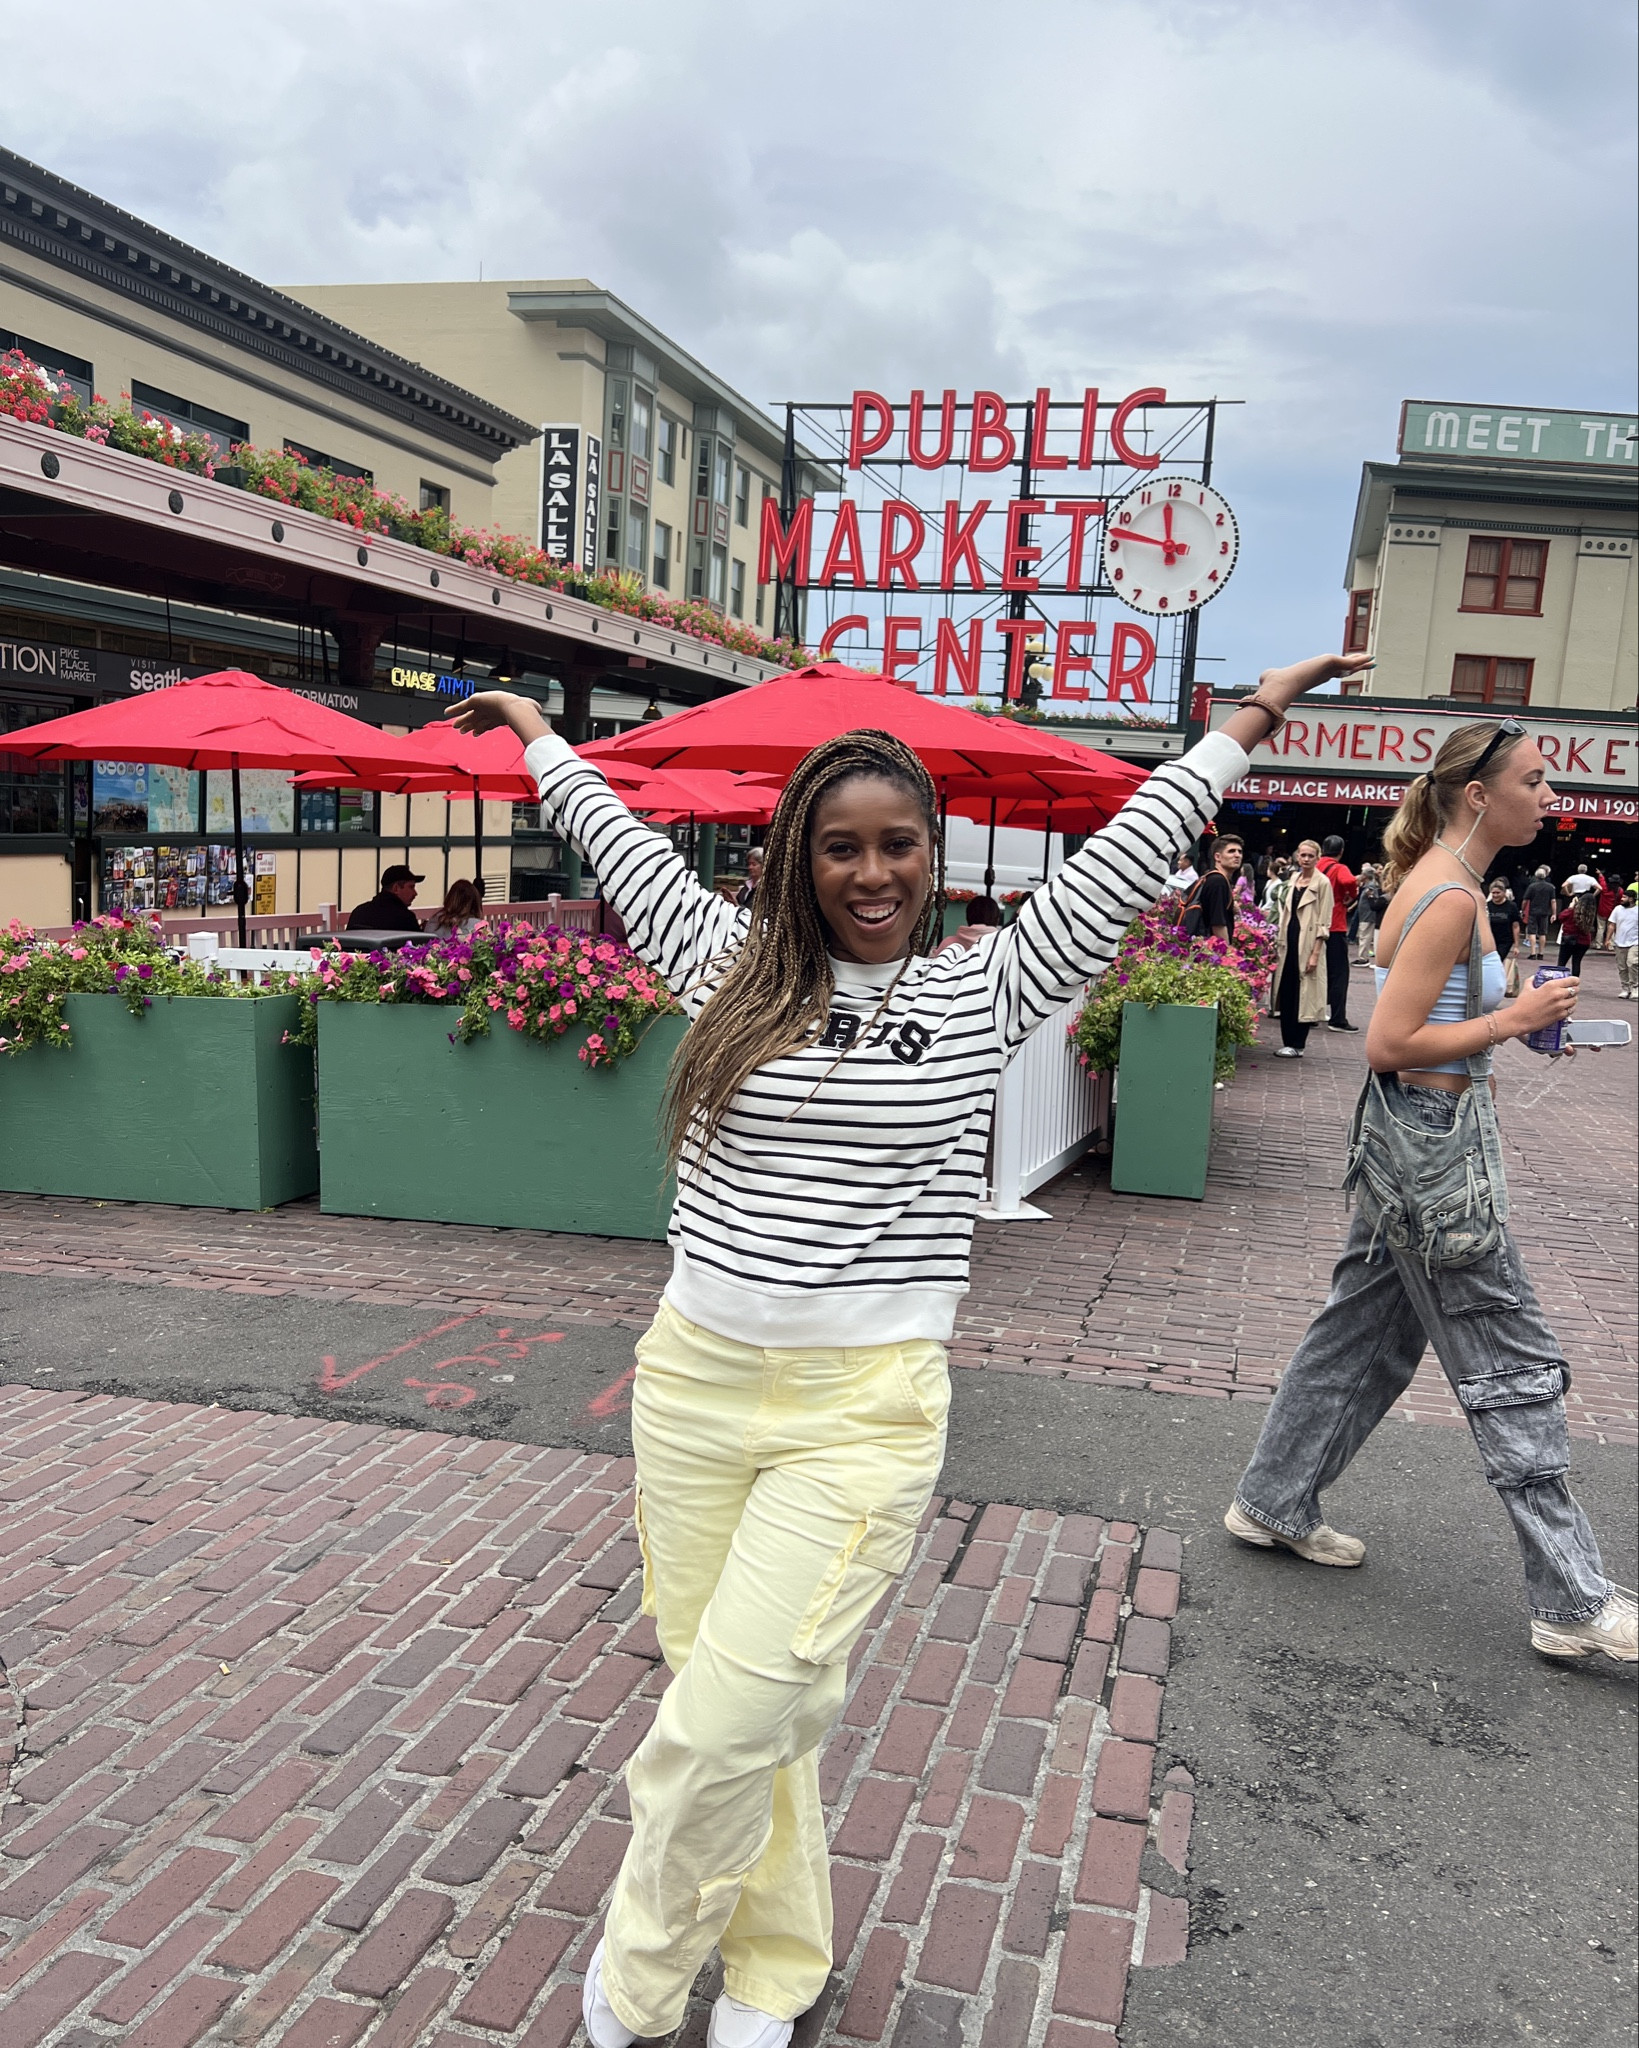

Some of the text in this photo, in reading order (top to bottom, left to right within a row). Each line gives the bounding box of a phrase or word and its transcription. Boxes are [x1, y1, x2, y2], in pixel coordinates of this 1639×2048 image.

[848, 387, 1167, 473] PUBLIC
[1424, 410, 1637, 460] MEET TH
[546, 432, 572, 559] LA SALLE
[1168, 483, 1182, 497] 12
[584, 439, 599, 567] LA SALLE
[1141, 491, 1152, 505] 11
[1199, 492, 1204, 505] 1
[1119, 511, 1132, 525] 10
[1215, 512, 1225, 526] 2
[757, 497, 1107, 593] MARKET
[1109, 539, 1120, 553] 9
[1219, 541, 1229, 555] 3
[1113, 567, 1124, 581] 8
[1207, 569, 1219, 582] 4
[1132, 588, 1142, 601] 7
[1188, 589, 1198, 603] 5
[1158, 596, 1169, 609] 6
[59, 647, 80, 660] PIKE
[818, 614, 1156, 704] CENTER
[59, 660, 90, 672] PLACE
[130, 658, 157, 670] VISIT
[60, 669, 97, 683] MARKET
[391, 666, 464, 697] CHASE ATM
[291, 688, 359, 710] FORMATION
[1258, 720, 1638, 776] RMERS RKE
[1229, 777, 1261, 794] IKE
[1267, 779, 1329, 798] PLACE
[1579, 797, 1599, 813] IN
[1603, 799, 1639, 817] 190
